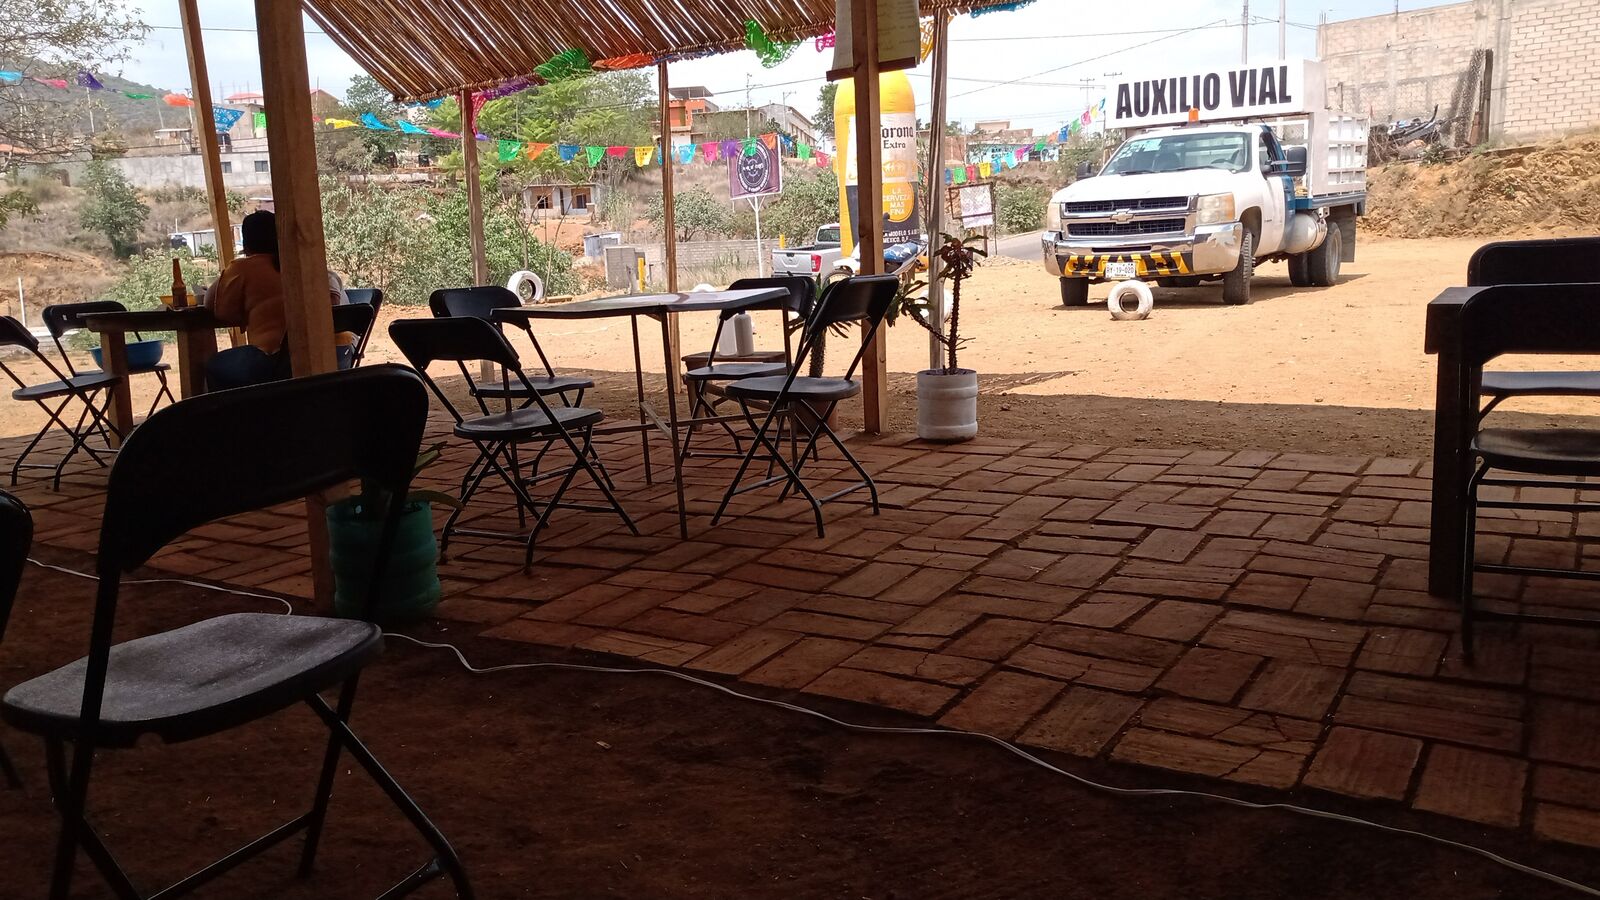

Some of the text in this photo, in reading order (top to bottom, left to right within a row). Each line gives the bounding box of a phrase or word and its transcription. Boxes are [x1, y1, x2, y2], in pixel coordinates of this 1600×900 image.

[1115, 65, 1292, 120] AUXILIO VIAL
[880, 125, 914, 139] orona
[883, 140, 906, 149] Extra
